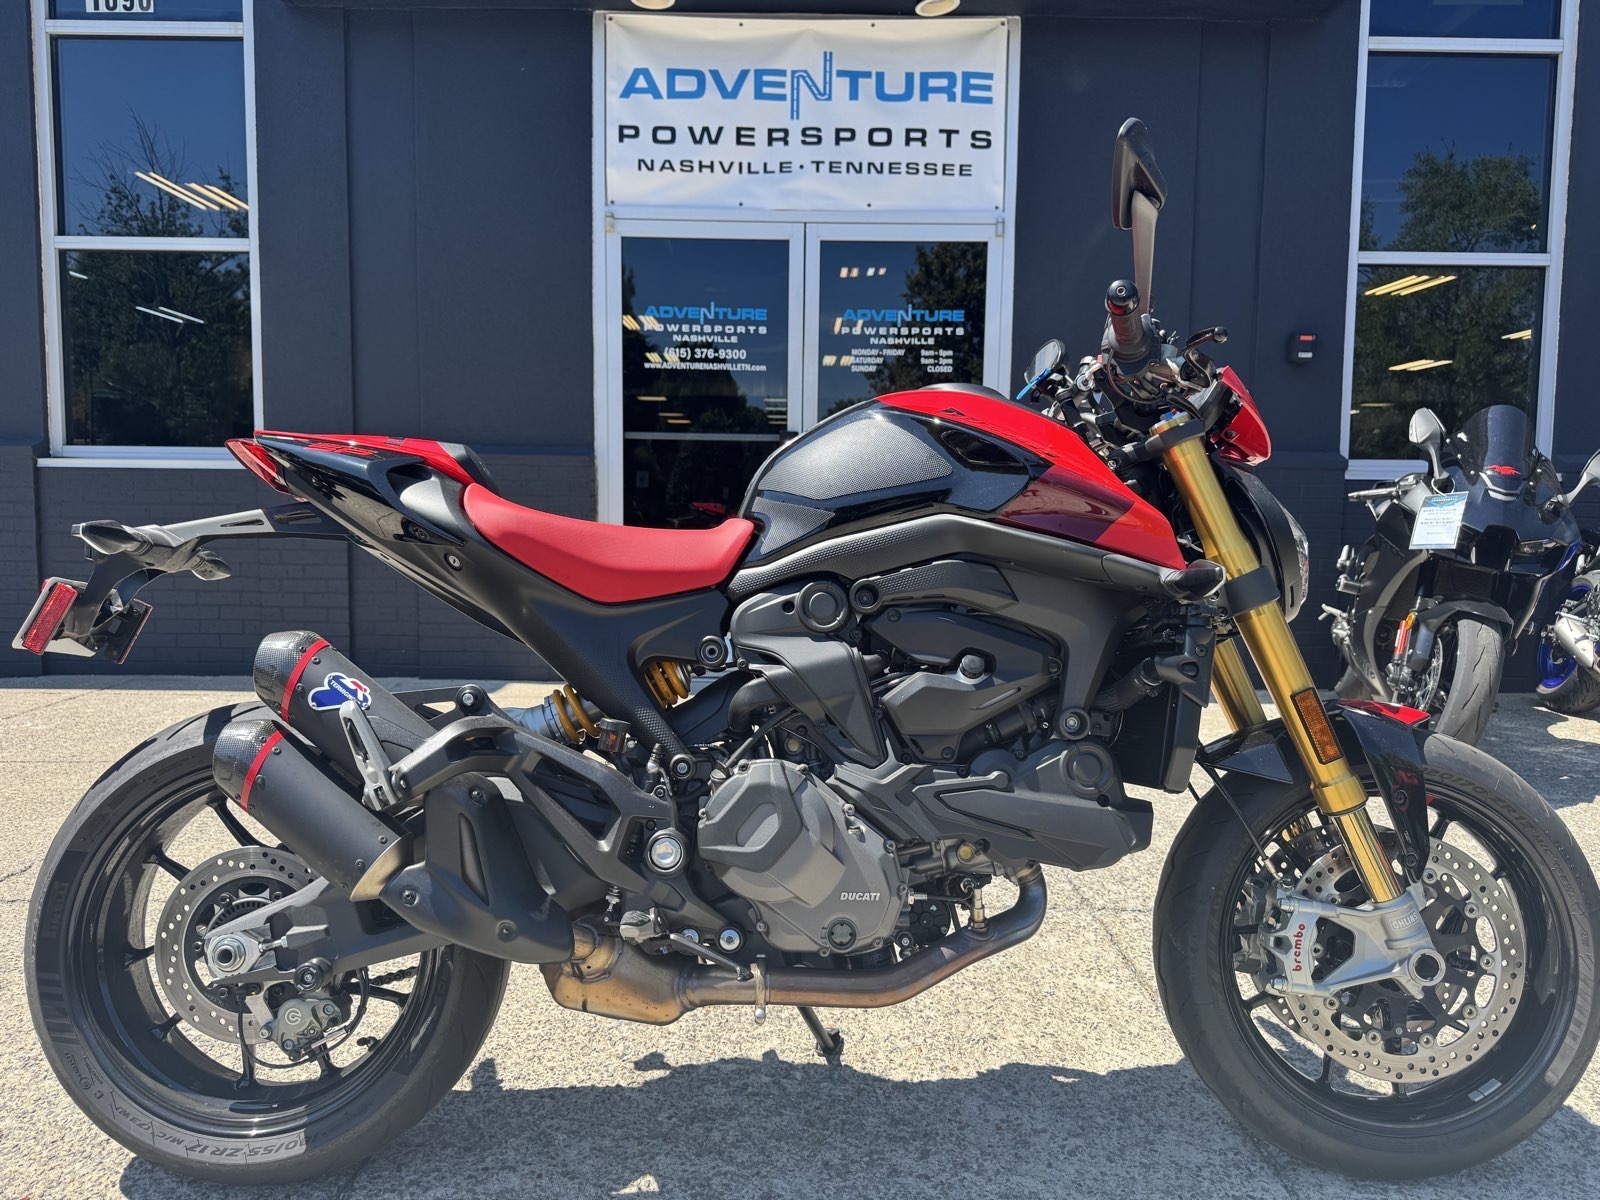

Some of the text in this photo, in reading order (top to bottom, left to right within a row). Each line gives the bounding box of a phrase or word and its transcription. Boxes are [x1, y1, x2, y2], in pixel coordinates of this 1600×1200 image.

[619, 51, 994, 120] ADVENTURE
[618, 124, 993, 150] POWERSPORTS
[637, 158, 973, 177] NASHVILLE TENNESSEE
[644, 301, 768, 325] ADVENTURE
[842, 304, 965, 327] ADVENTURE
[644, 323, 768, 334] POWERSPORTS
[841, 326, 965, 336] POWERSPORTS
[672, 335, 739, 344] NASHVILLE
[870, 337, 935, 345] NASHVILLE
[663, 347, 747, 360] (615) 376-9300
[851, 348, 879, 356] MONDAY
[882, 348, 906, 356] FRIDAY
[926, 365, 953, 373] CLOSED
[840, 892, 881, 901] DUCATI
[1291, 922, 1307, 972] brembo
